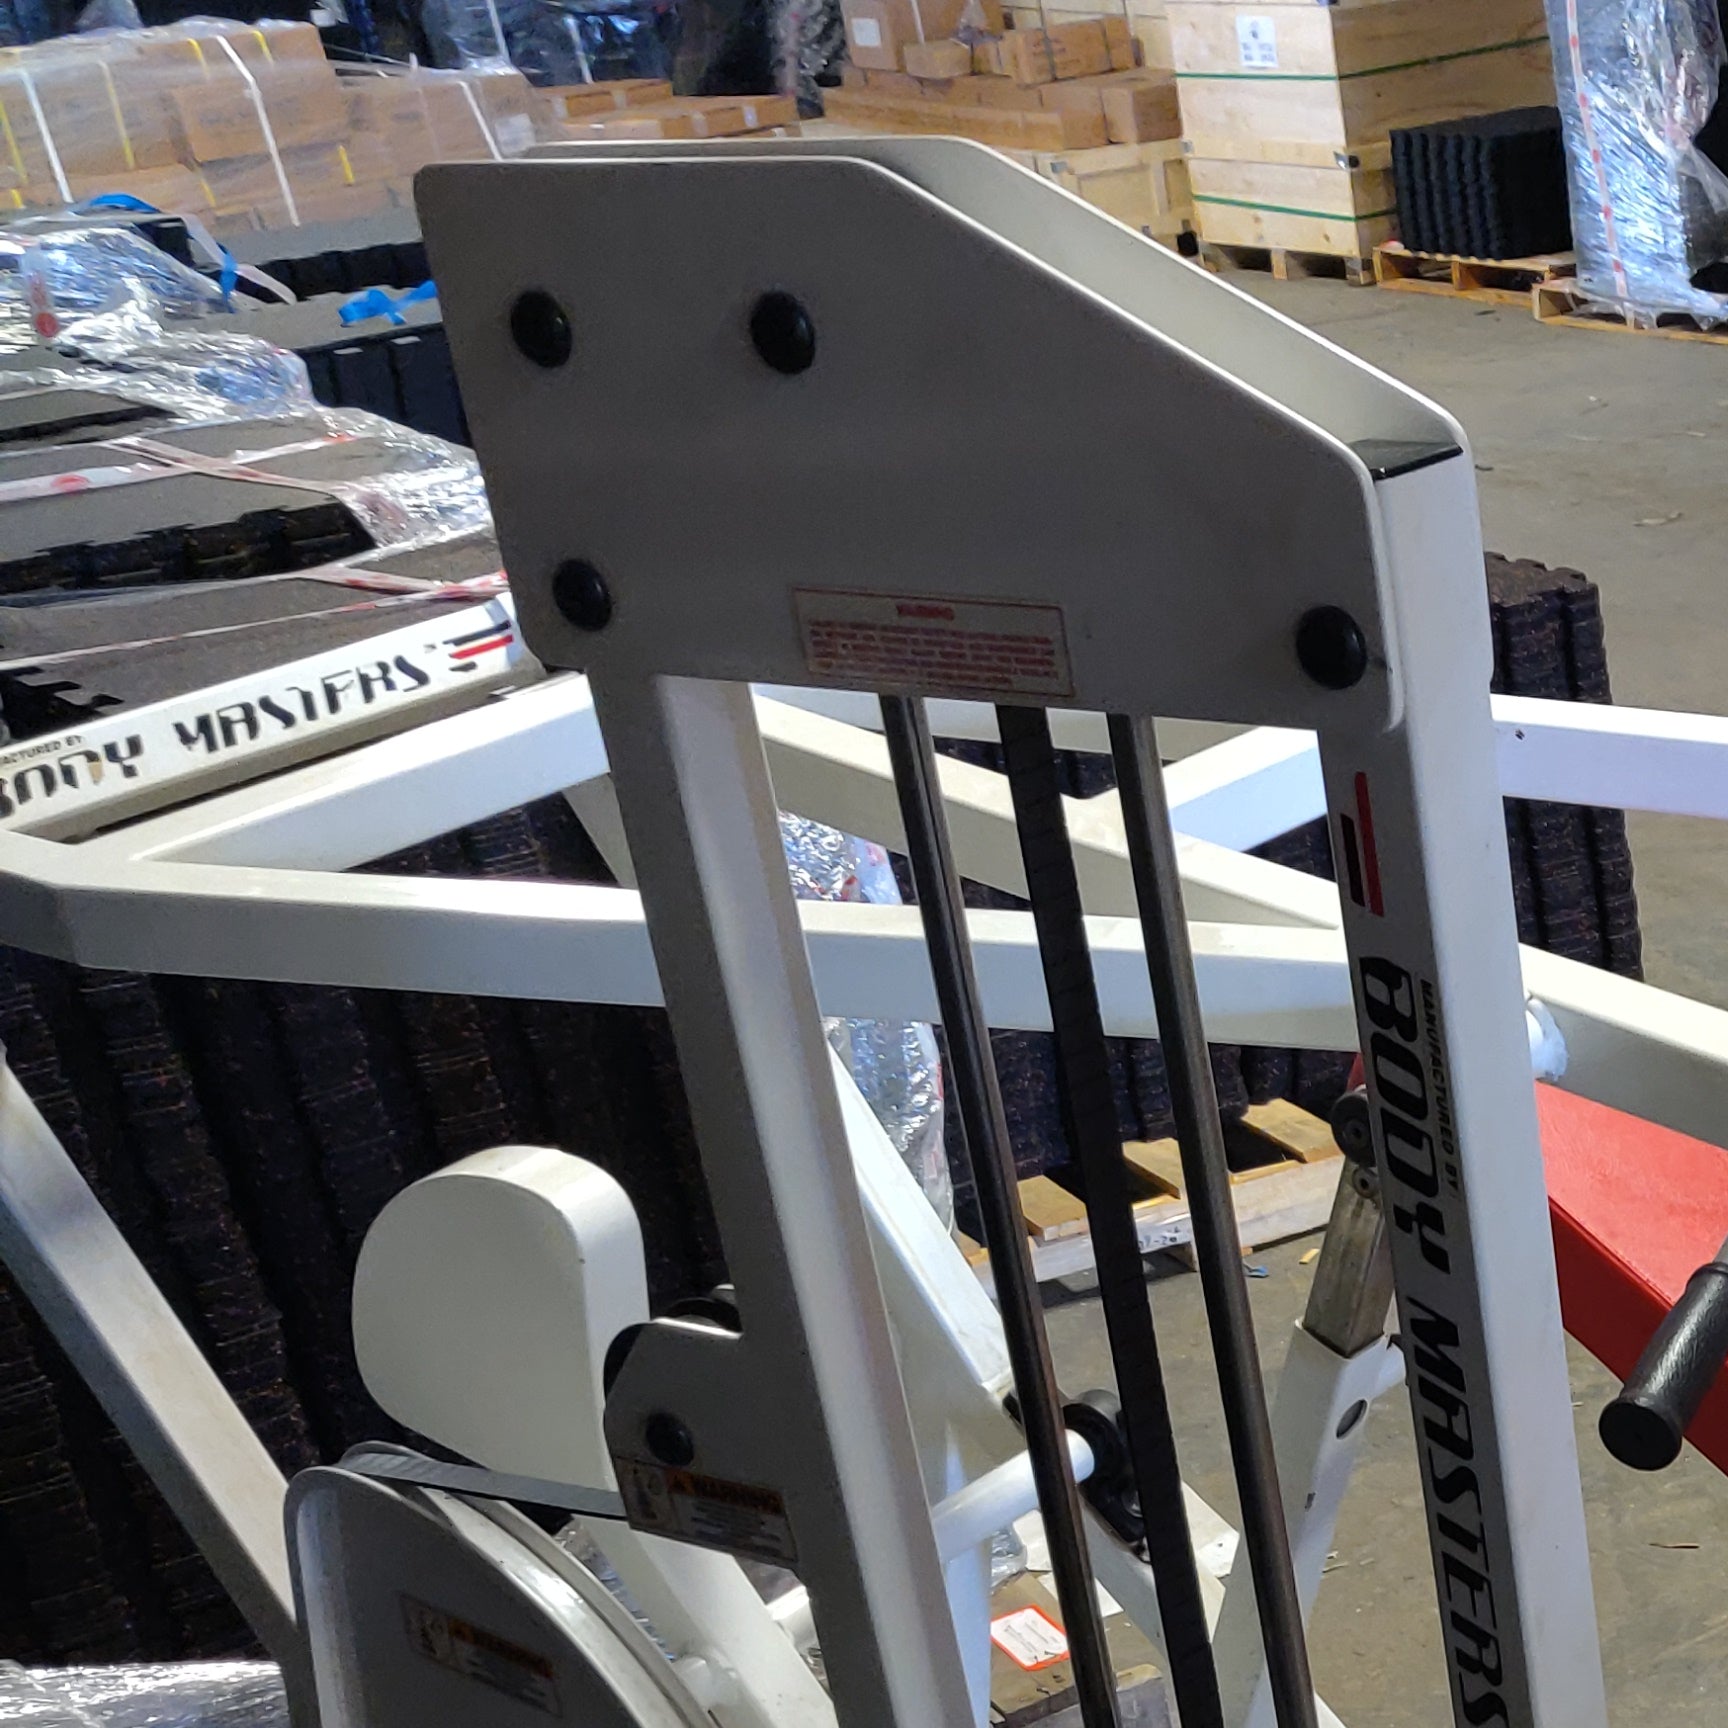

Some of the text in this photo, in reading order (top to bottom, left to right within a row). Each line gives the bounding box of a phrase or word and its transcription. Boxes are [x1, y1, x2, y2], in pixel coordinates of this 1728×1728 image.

[172, 655, 430, 753] MASTERS
[1359, 956, 1450, 1275] BODY
[1420, 978, 1456, 1156] MANUFACTURED
